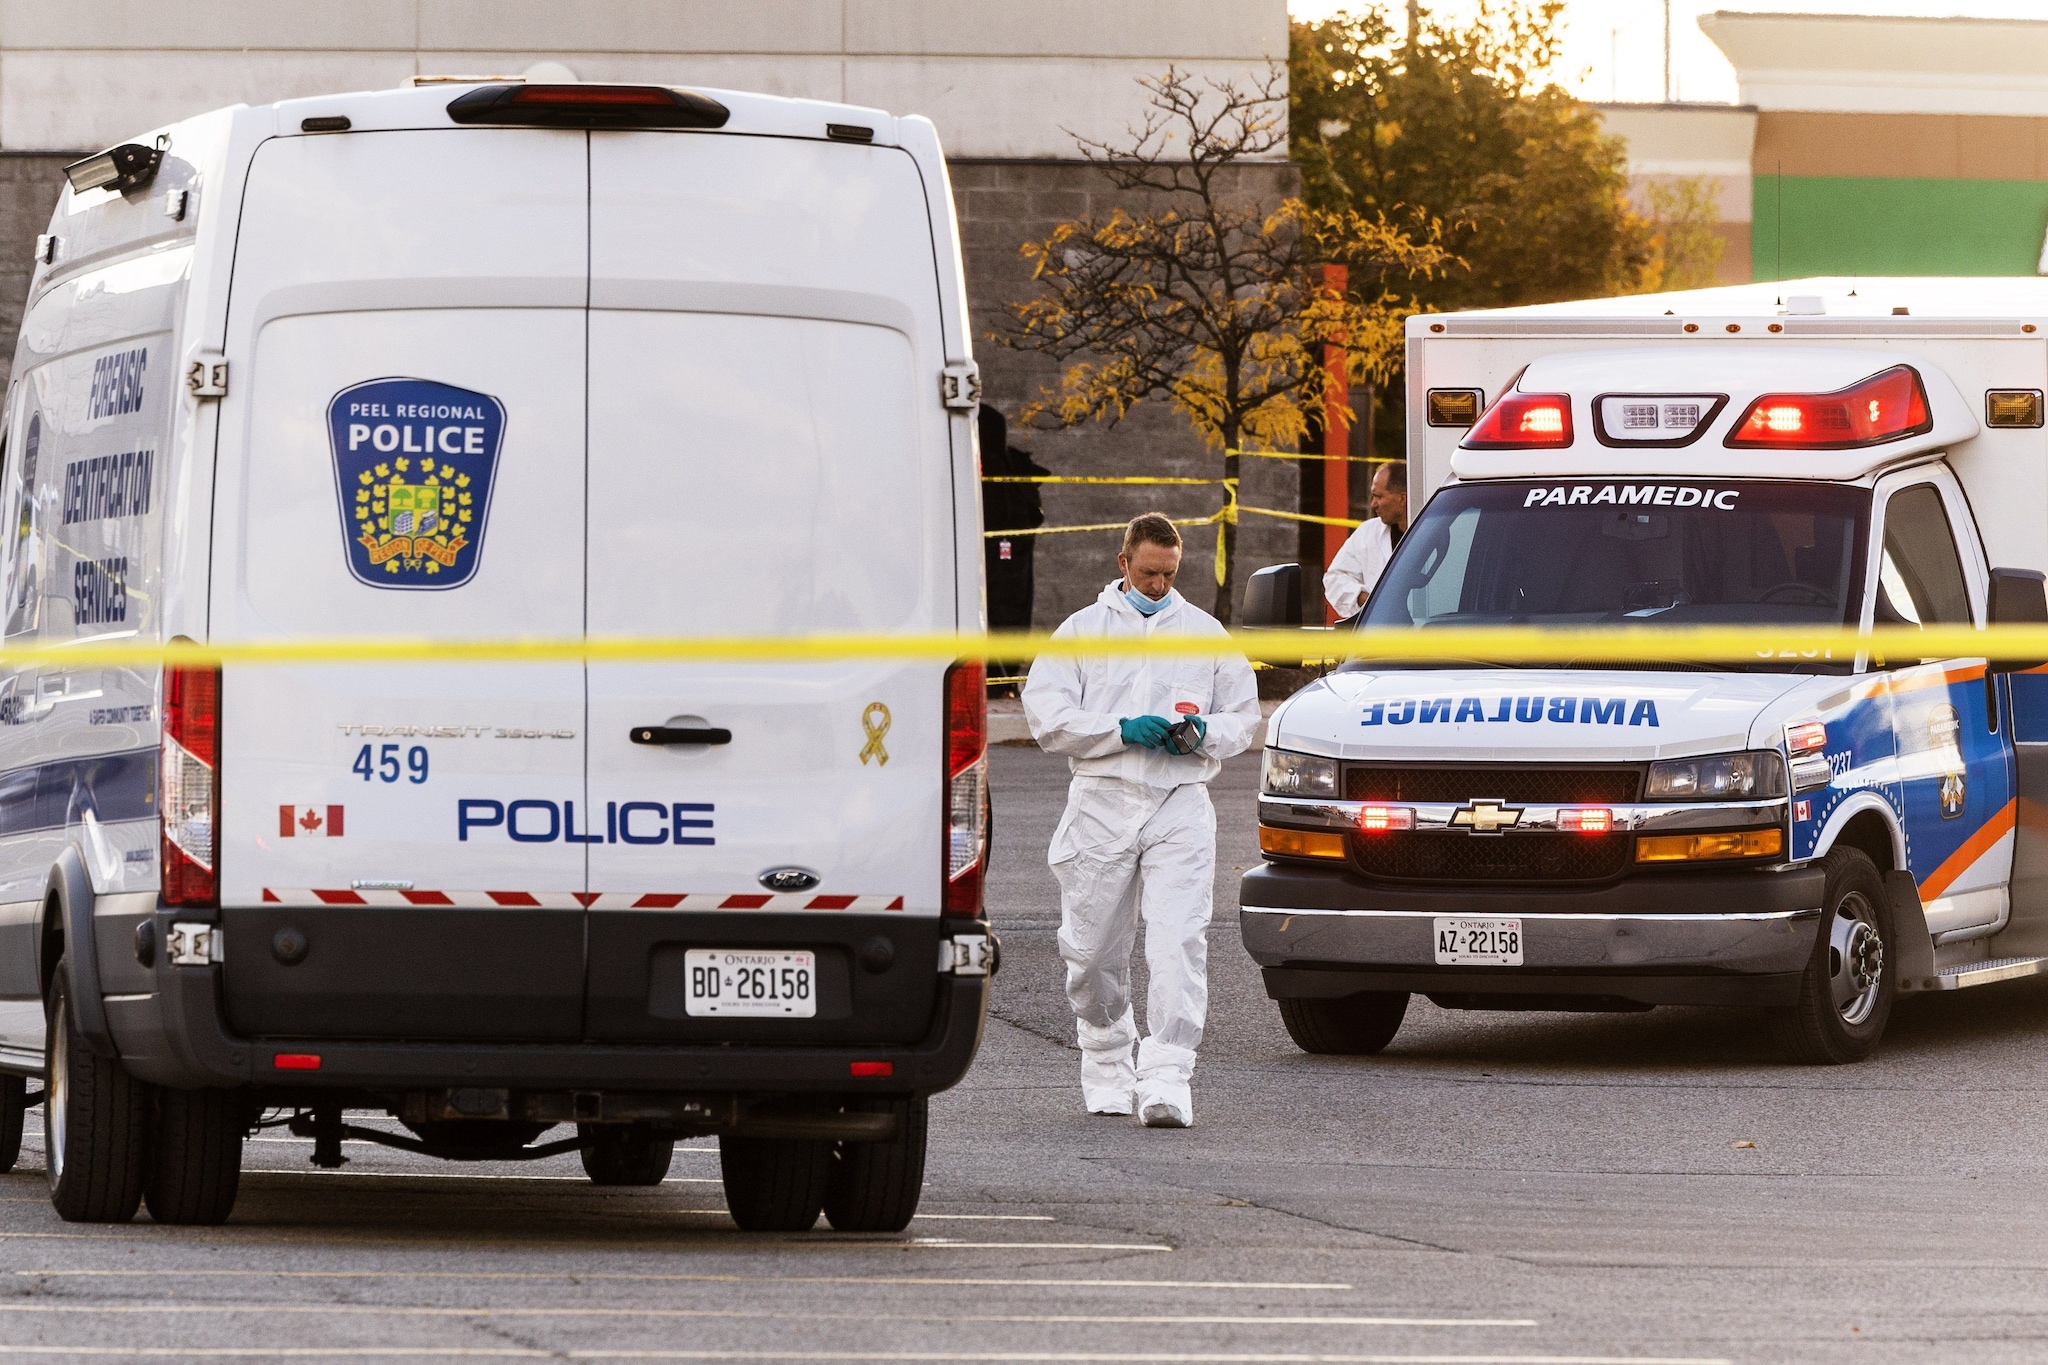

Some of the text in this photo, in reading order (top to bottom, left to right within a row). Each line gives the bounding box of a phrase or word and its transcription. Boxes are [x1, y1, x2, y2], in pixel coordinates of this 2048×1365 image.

[87, 347, 147, 420] FORENSIC
[350, 403, 485, 420] PEEL REGIONAL
[349, 424, 485, 454] POLICE
[62, 450, 154, 525] IDENTIFICATION
[1523, 485, 1739, 510] PARAMEDIC
[74, 556, 128, 625] SERVICES
[337, 724, 491, 738] TRANSIT
[352, 744, 429, 784] 459
[1827, 750, 1852, 782] 3237
[458, 799, 715, 845] POLICE
[773, 871, 807, 886] Ford
[1439, 930, 1519, 954] AZ 22158
[693, 966, 809, 1000] BD 26158
